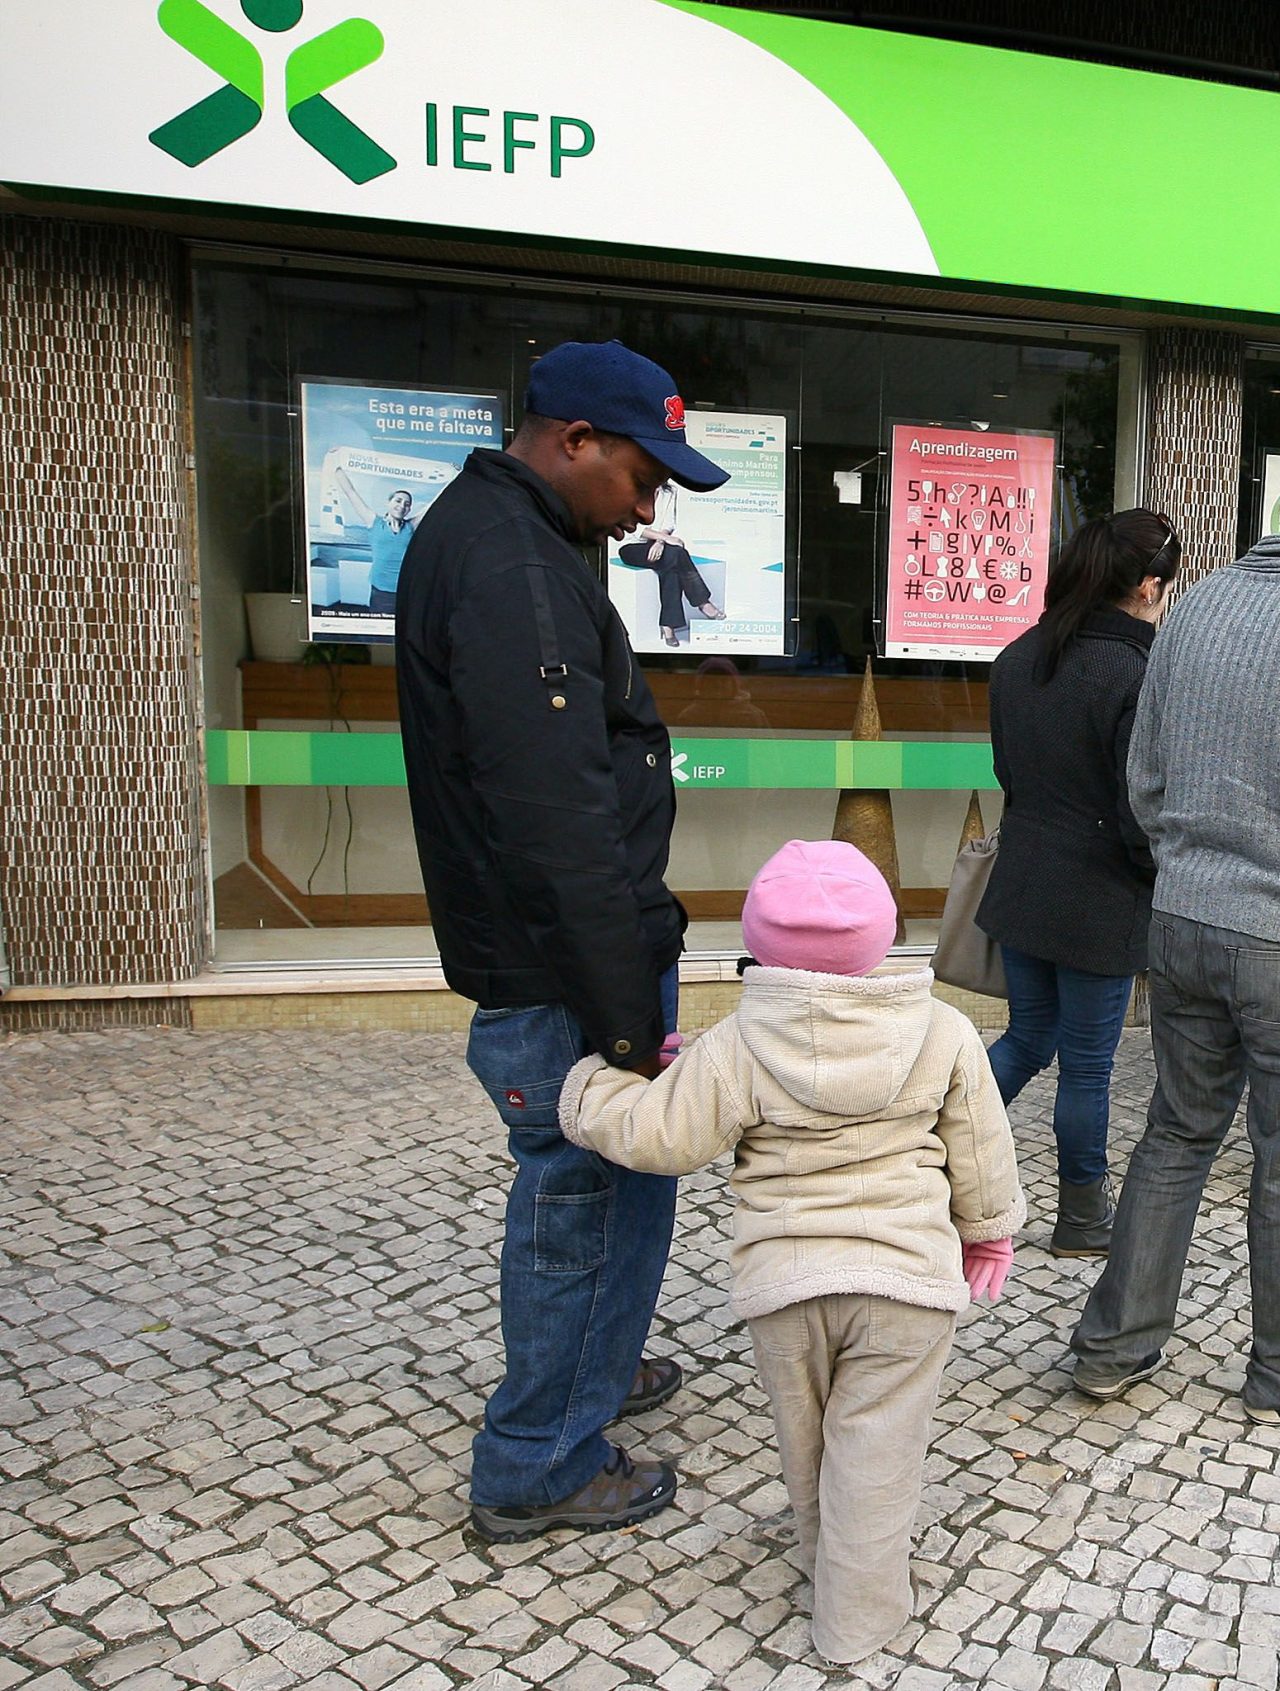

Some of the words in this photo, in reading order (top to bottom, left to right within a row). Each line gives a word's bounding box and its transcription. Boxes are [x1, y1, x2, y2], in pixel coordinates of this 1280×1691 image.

[425, 102, 595, 178] IEFP
[368, 399, 404, 414] Esta
[408, 405, 434, 417] era
[439, 407, 448, 418] a
[453, 408, 493, 421] meta
[376, 418, 405, 432] que
[410, 420, 434, 432] me
[439, 420, 493, 436] faltava
[909, 438, 1018, 462] Aprendizagem
[348, 461, 424, 479] OPORTUNIDADES
[903, 611, 919, 619] COM
[920, 612, 944, 620] TEORIA
[994, 616, 1030, 624] EMPRESAS
[903, 620, 941, 629] FORMAMOS
[943, 622, 993, 631] PROFISSIONAIS
[693, 766, 725, 779] IEFP
